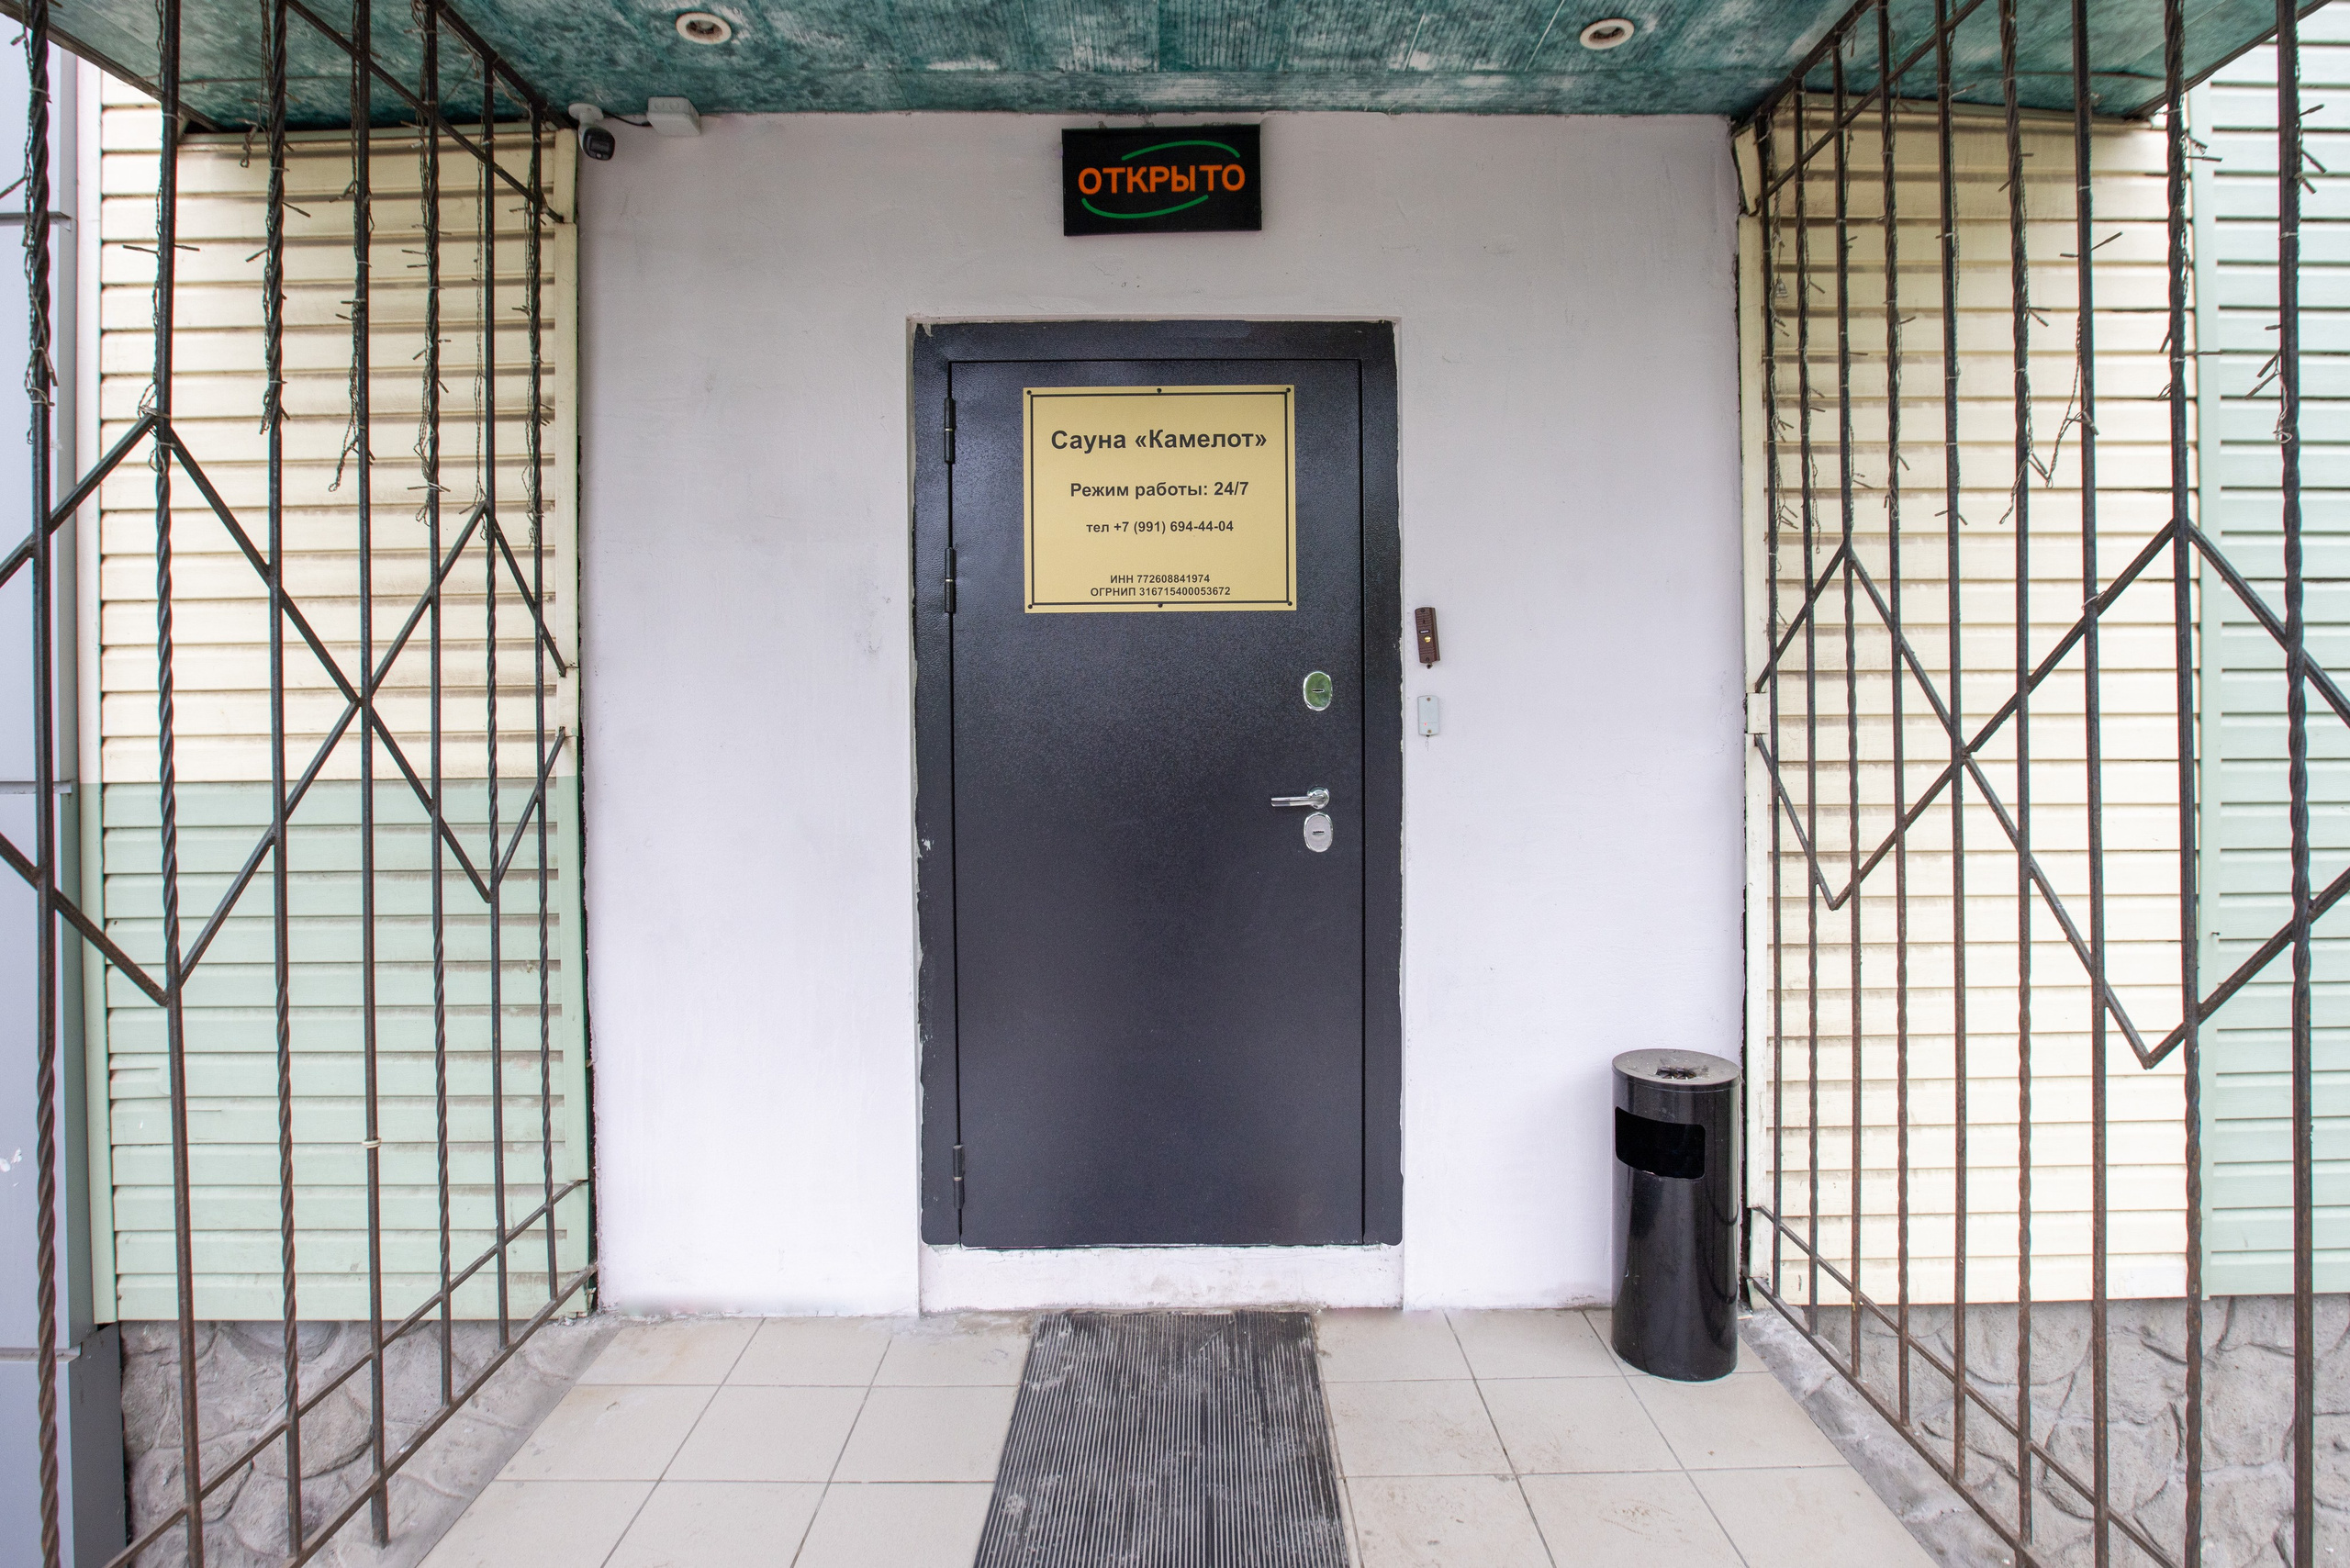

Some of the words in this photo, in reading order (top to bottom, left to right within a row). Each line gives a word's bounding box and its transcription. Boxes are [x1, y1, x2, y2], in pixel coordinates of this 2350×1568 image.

[1078, 163, 1246, 195] ОТКРЫТО
[1051, 430, 1126, 454] Сауна
[1135, 429, 1268, 449] «Камелот»
[1070, 483, 1129, 498] Режим
[1135, 481, 1208, 500] работы:
[1214, 481, 1249, 496] 24/7
[1086, 523, 1110, 533] тел
[1113, 521, 1130, 532] +7
[1134, 521, 1166, 535] (991)
[1169, 520, 1234, 532] 694-44-04
[1110, 575, 1134, 584] ИНН
[1136, 574, 1211, 584] 772608841974
[1090, 587, 1136, 597] ОГРНИП
[1139, 586, 1231, 597] 316715400053672
